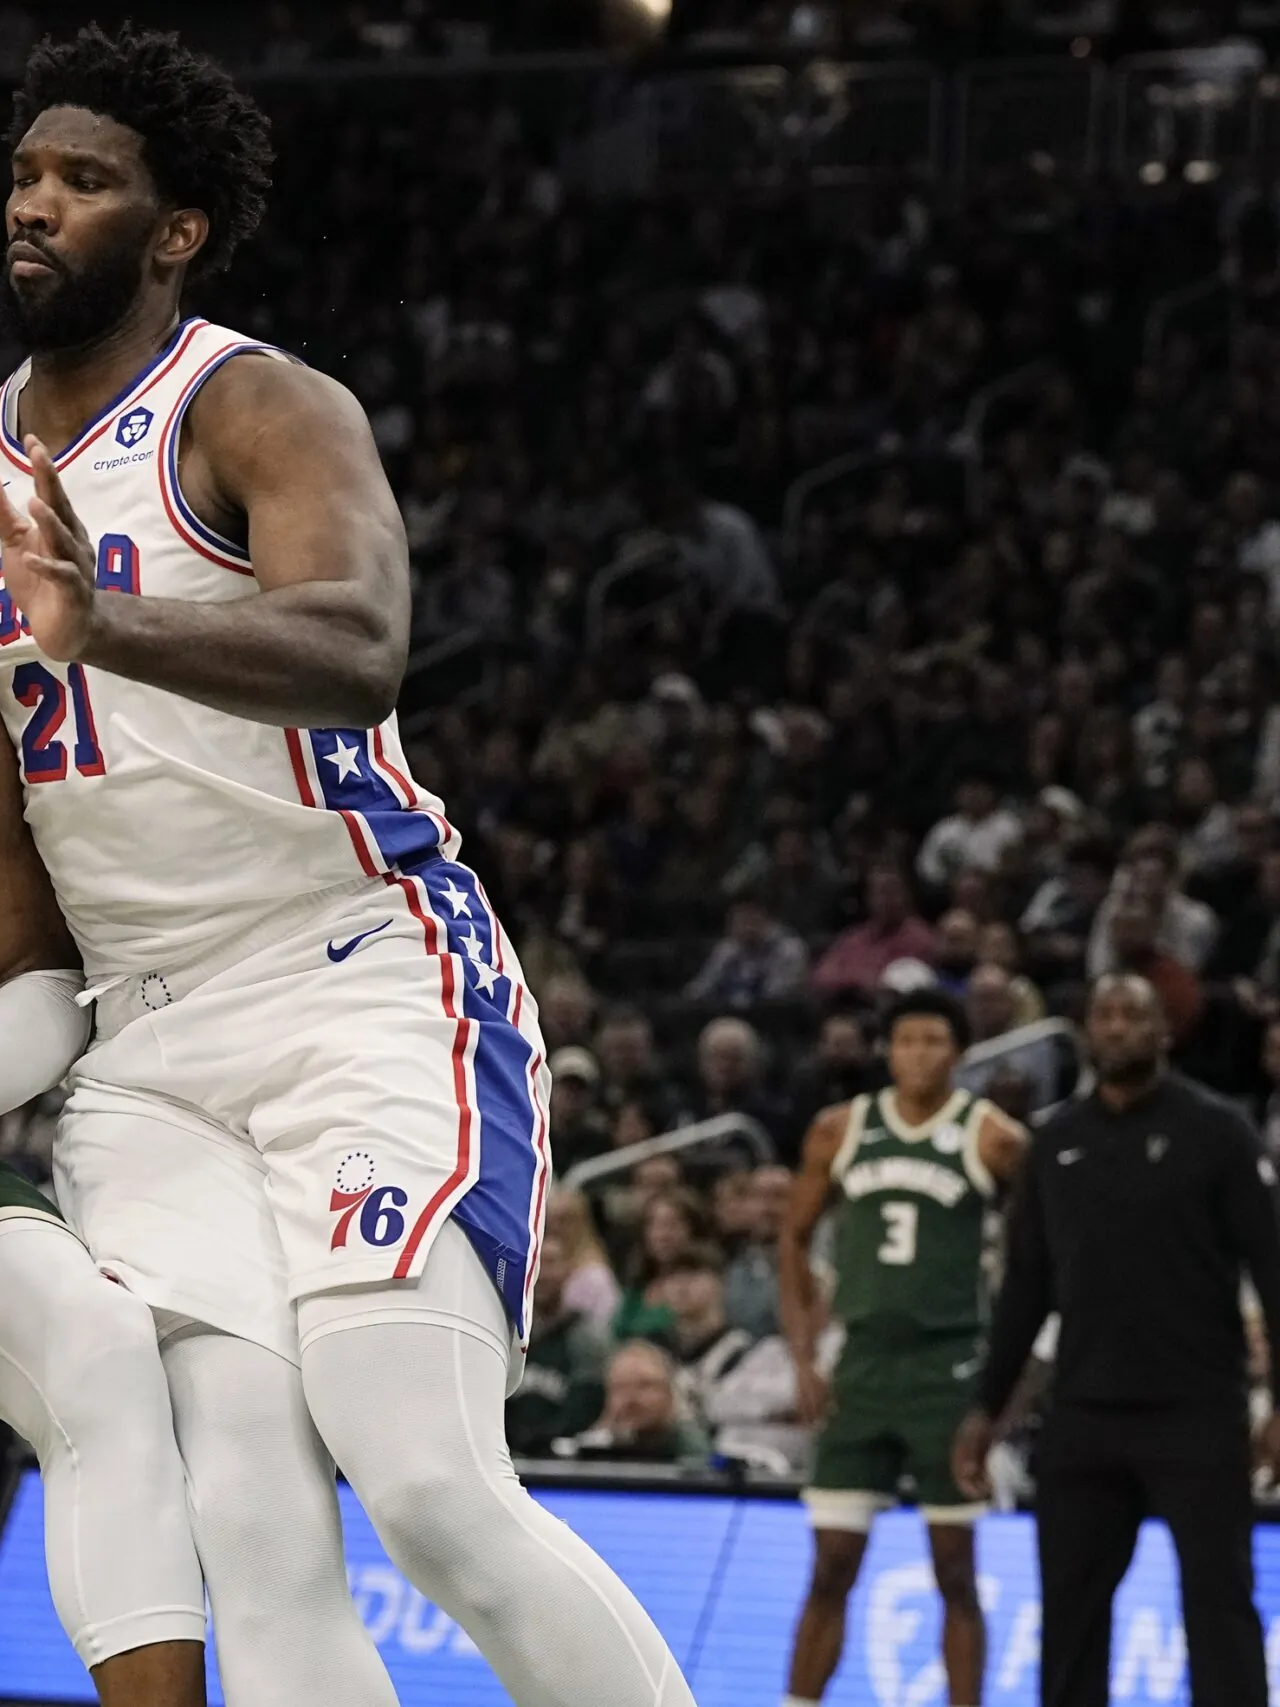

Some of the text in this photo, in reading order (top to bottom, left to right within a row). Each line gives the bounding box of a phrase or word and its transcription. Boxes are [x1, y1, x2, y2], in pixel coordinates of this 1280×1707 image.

[93, 449, 154, 470] crypto.com
[12, 661, 106, 784] 21
[329, 1184, 408, 1253] 76
[877, 1201, 919, 1265] 3
